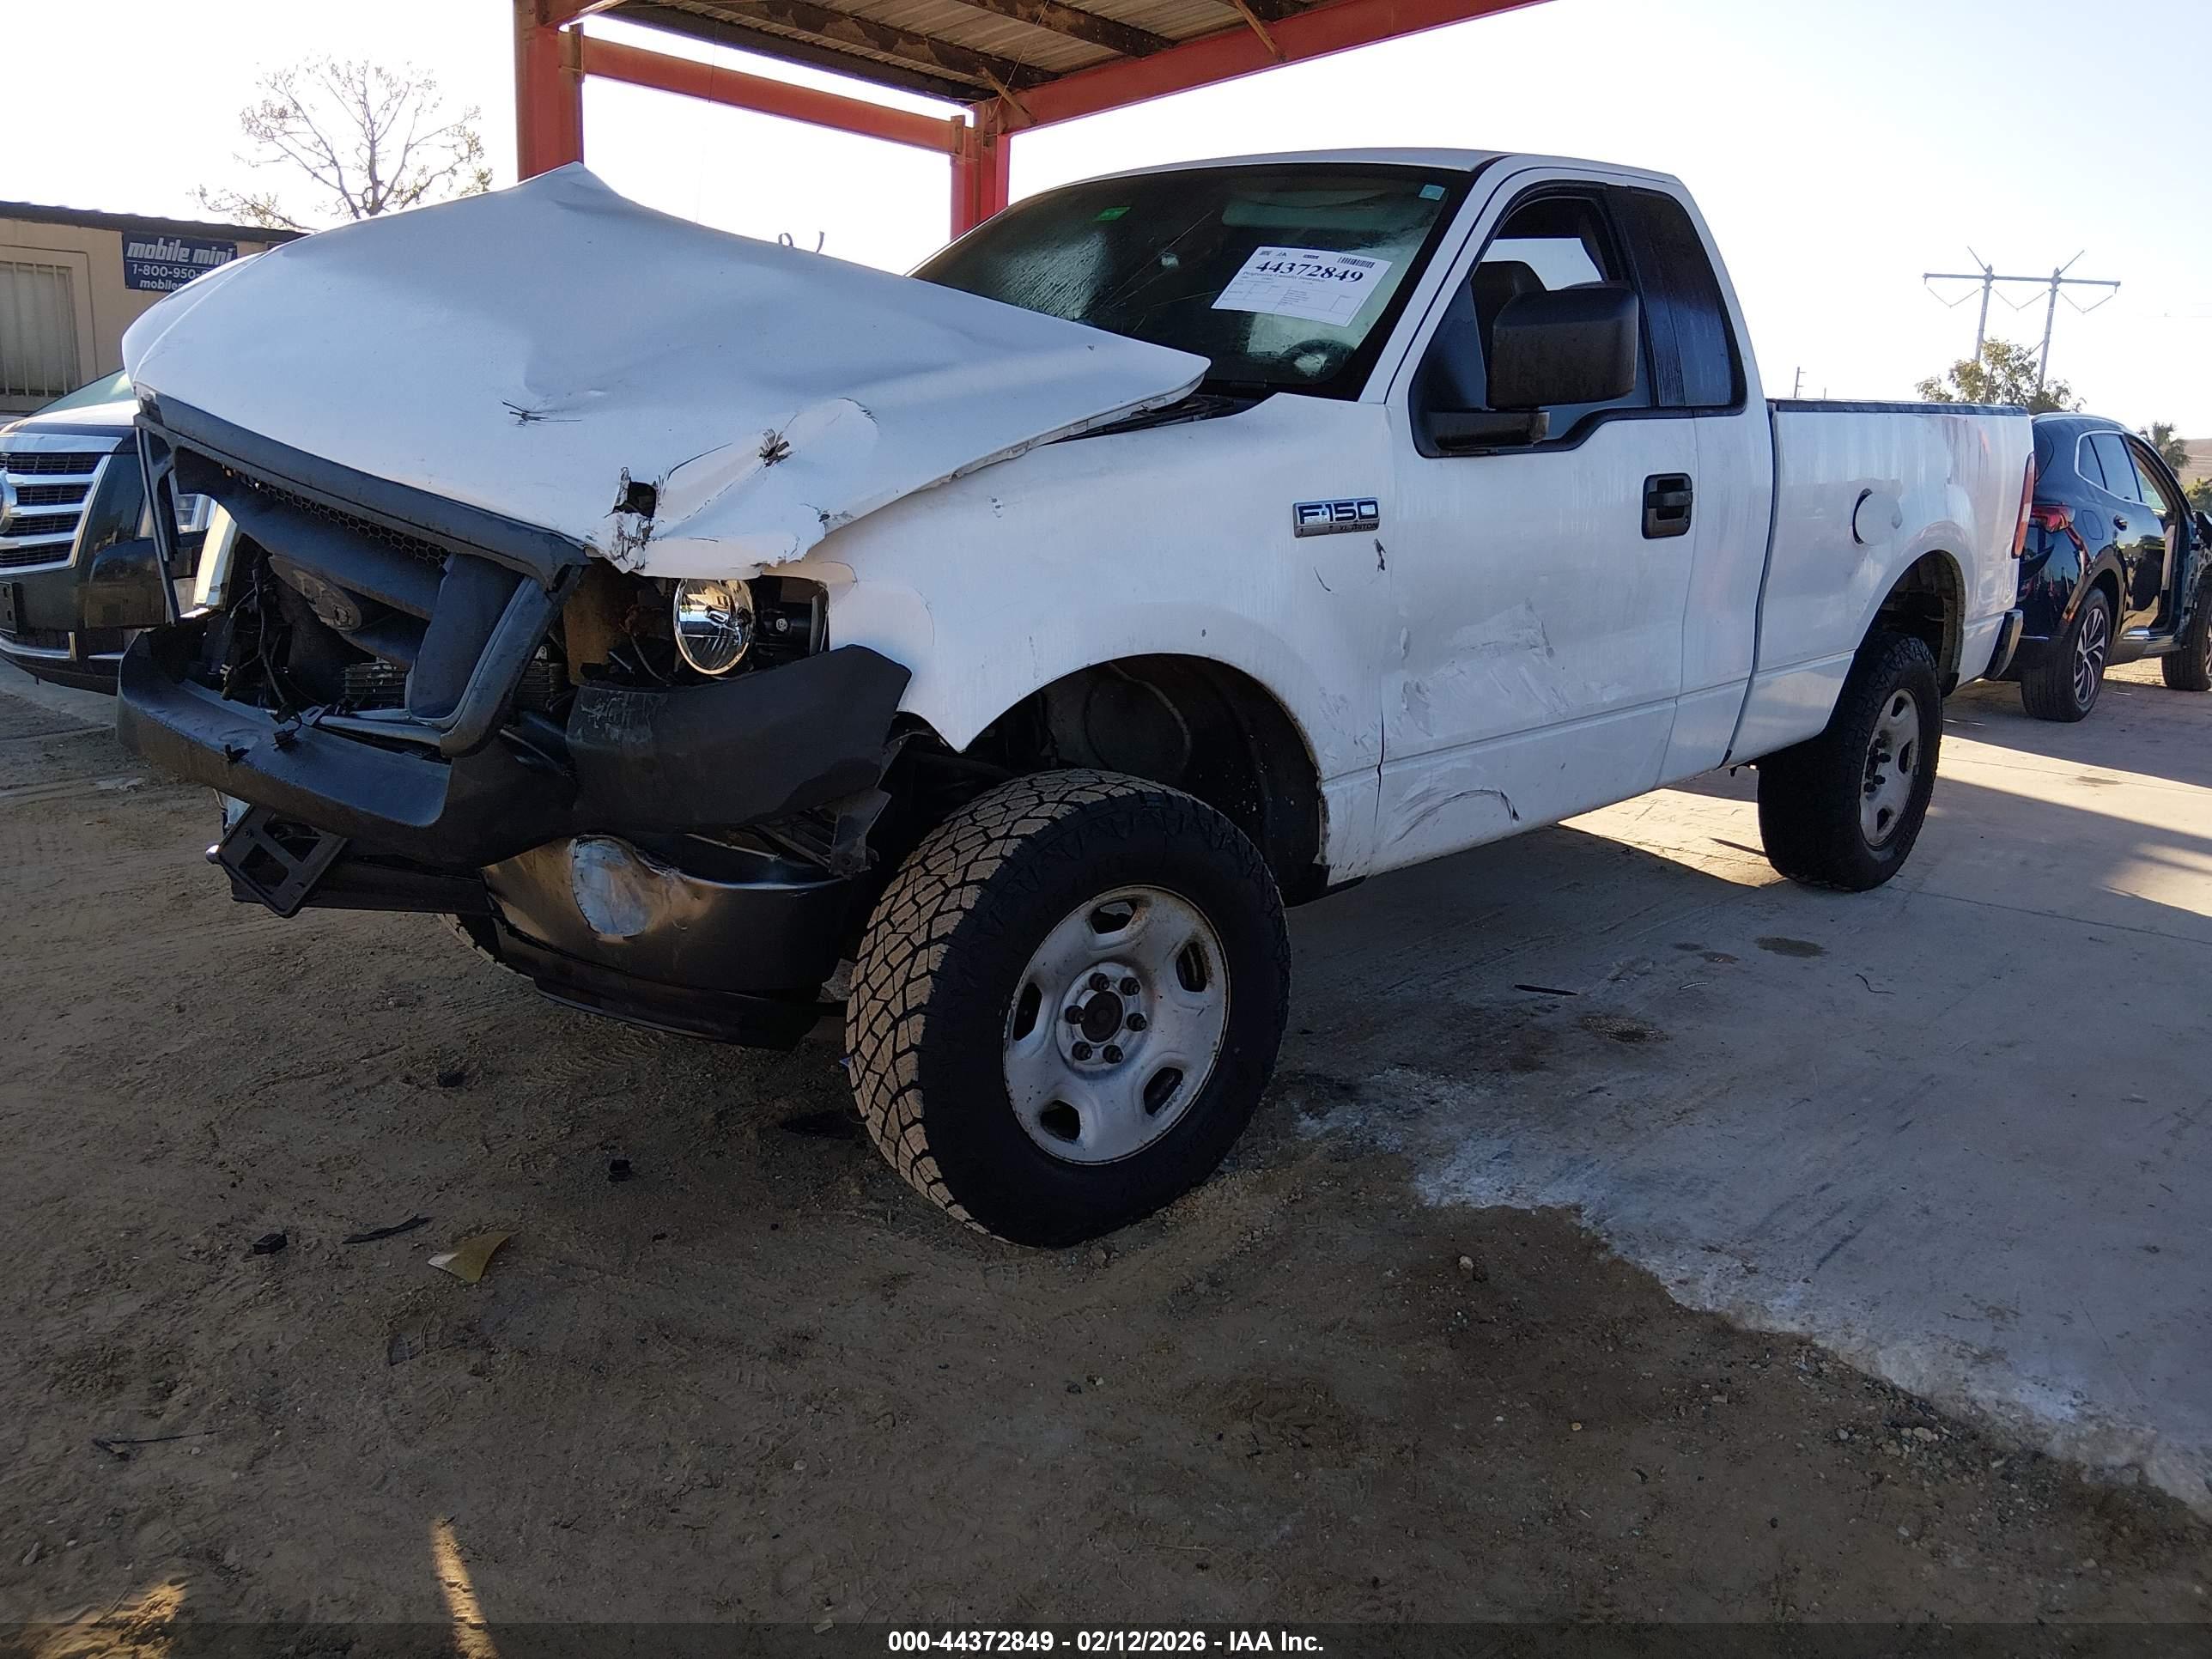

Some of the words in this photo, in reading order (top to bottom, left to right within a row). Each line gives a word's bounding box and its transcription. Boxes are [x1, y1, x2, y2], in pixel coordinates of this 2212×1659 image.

[127, 237, 190, 263] mobile
[192, 246, 234, 265] mini
[1256, 260, 1364, 283] 44372849
